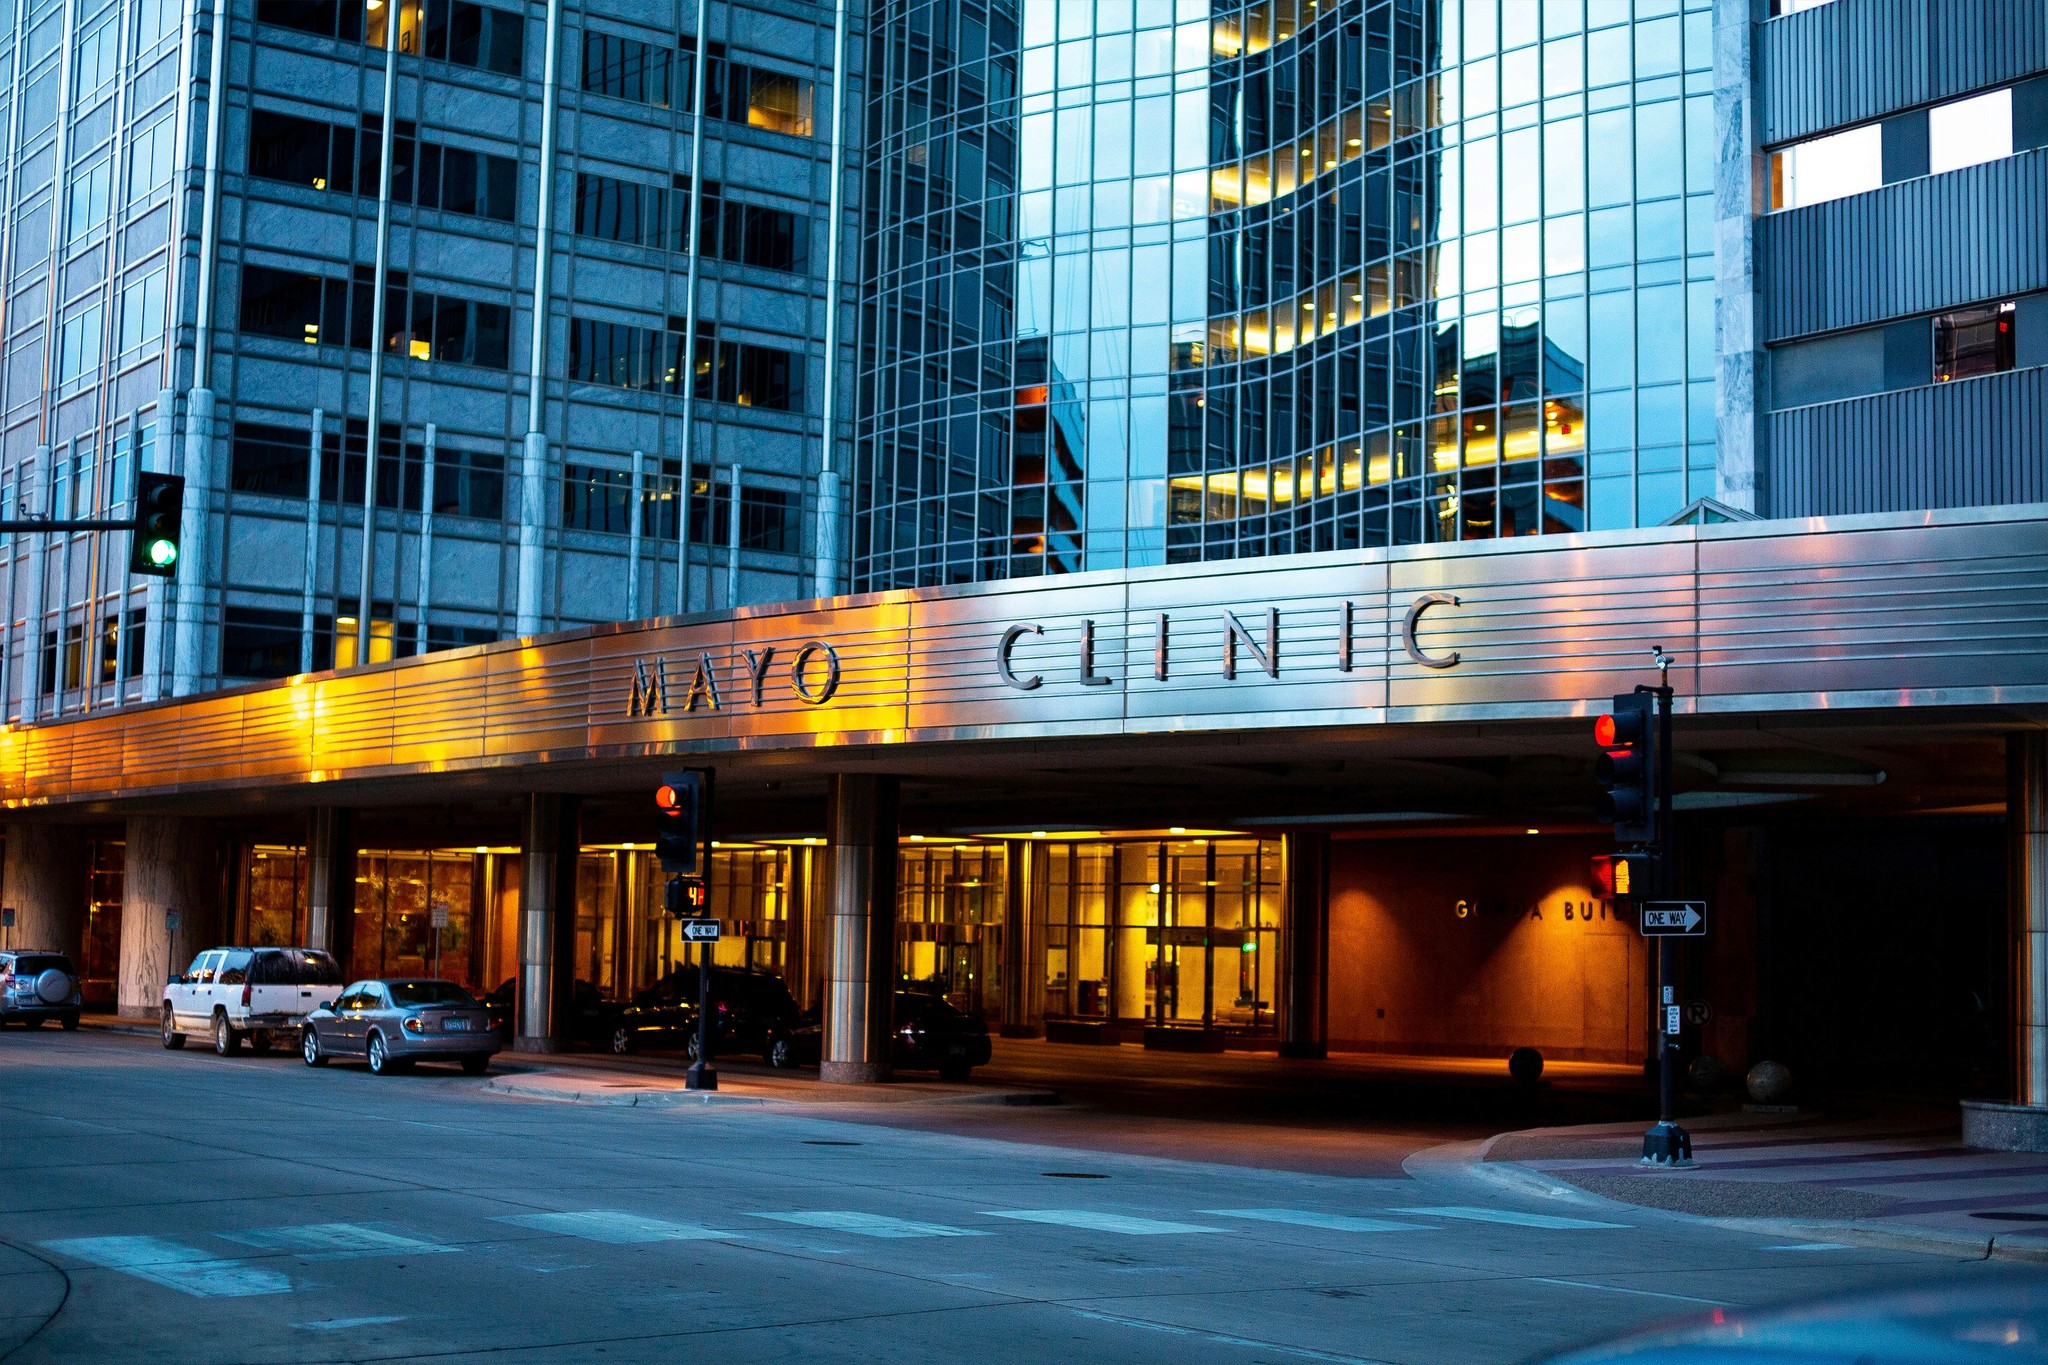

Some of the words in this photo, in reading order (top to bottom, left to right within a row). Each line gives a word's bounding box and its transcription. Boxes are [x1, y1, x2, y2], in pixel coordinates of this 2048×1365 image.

[626, 641, 840, 717] MAYO
[996, 592, 1460, 691] CLINIC
[1648, 912, 1665, 925] ONE
[1669, 912, 1687, 925] WAY
[691, 926, 702, 935] ONE
[705, 926, 716, 935] WAY
